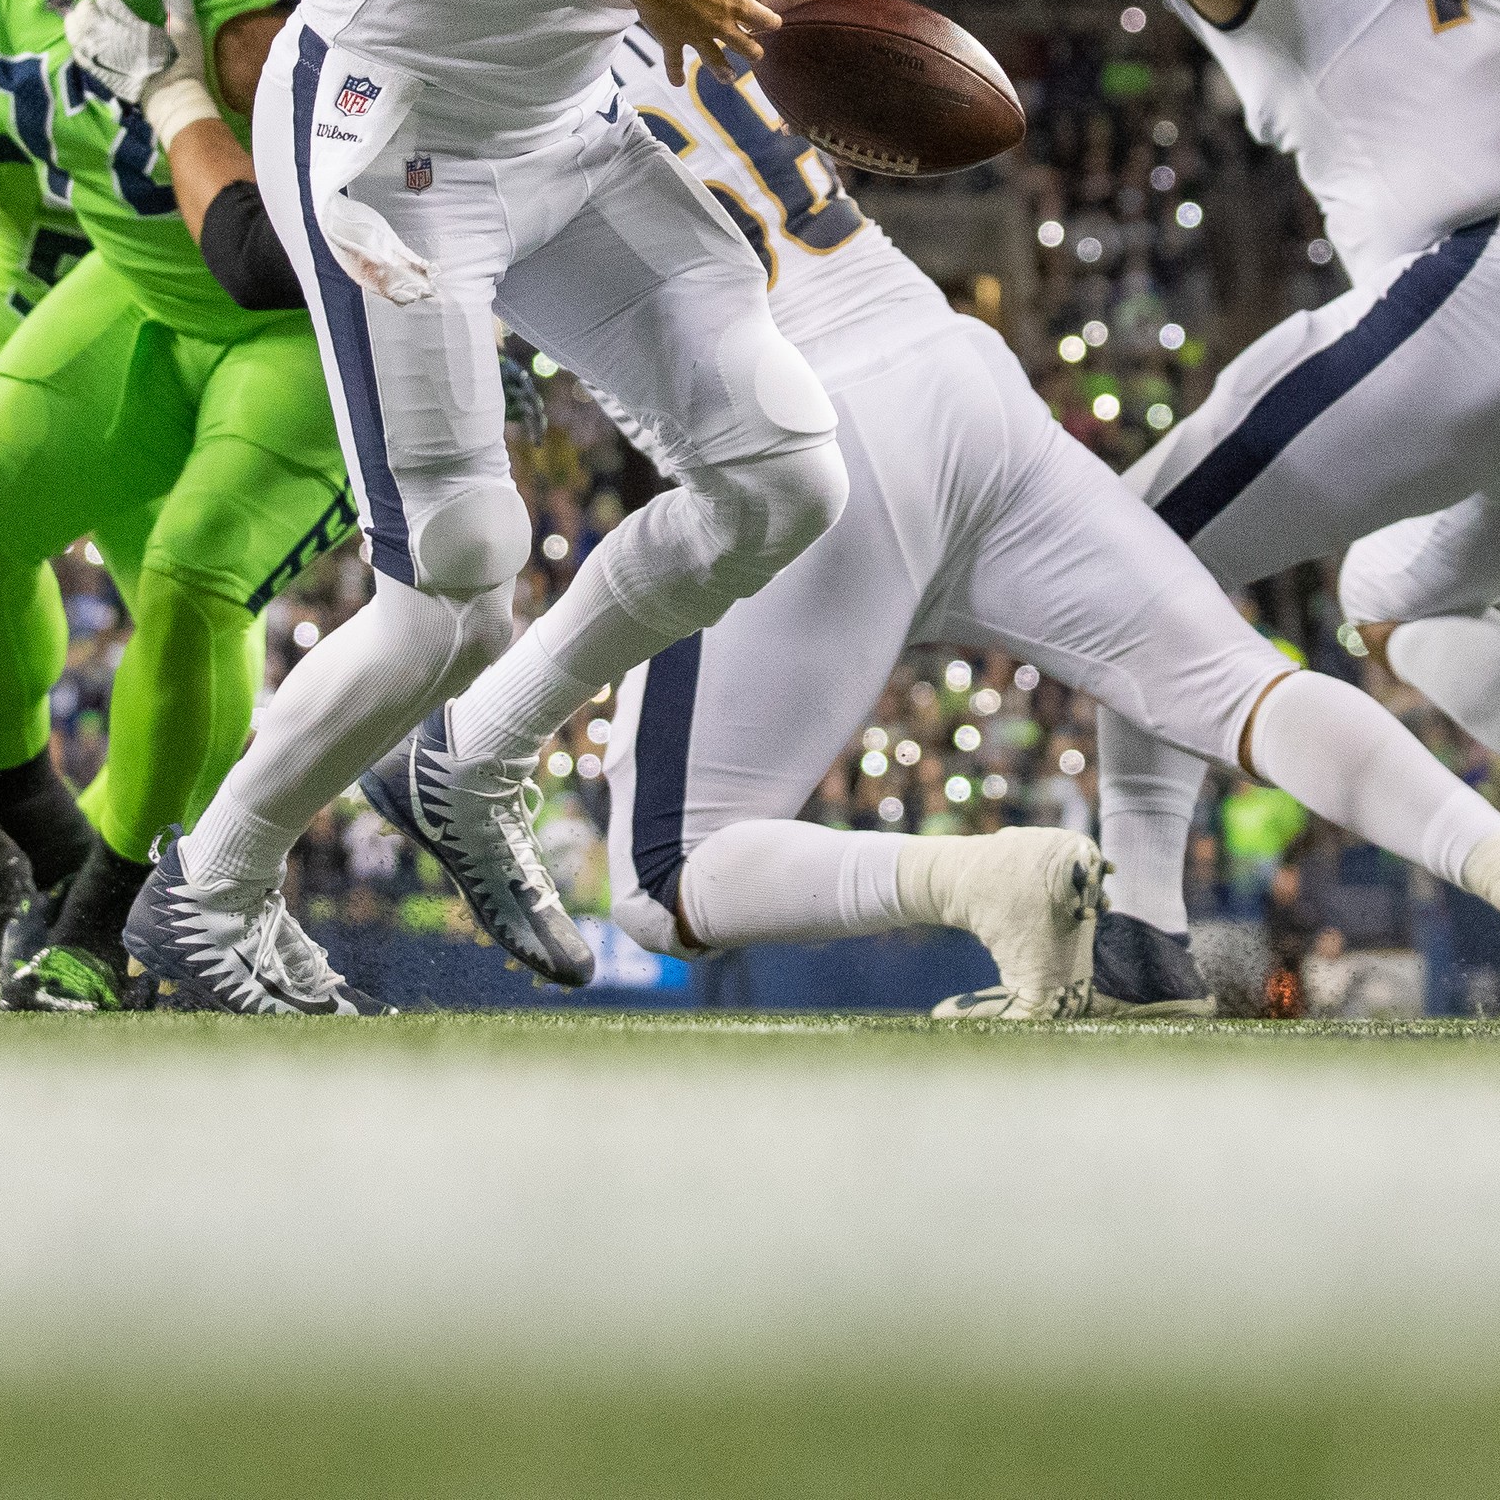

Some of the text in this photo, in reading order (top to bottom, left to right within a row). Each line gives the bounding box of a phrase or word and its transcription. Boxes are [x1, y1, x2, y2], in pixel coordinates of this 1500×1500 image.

[338, 90, 369, 114] NFL
[317, 123, 358, 143] Wilson
[408, 170, 431, 187] NFL
